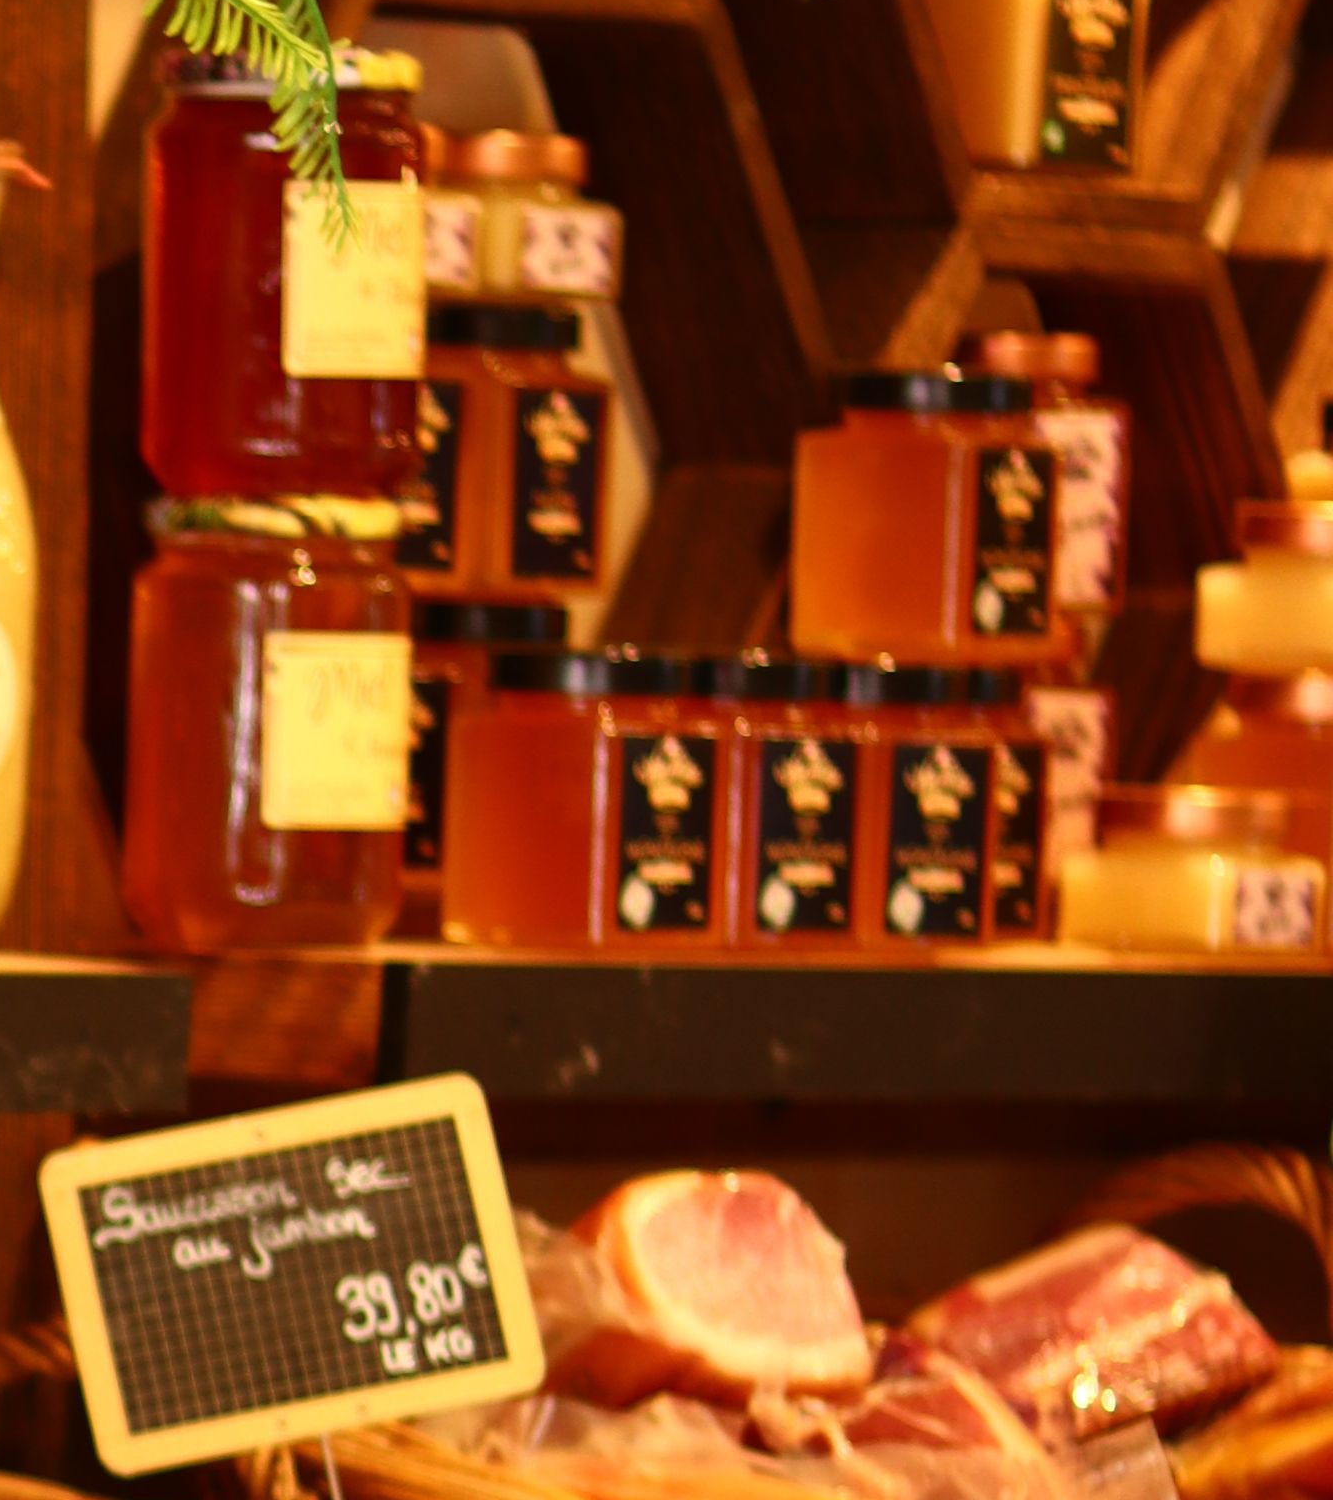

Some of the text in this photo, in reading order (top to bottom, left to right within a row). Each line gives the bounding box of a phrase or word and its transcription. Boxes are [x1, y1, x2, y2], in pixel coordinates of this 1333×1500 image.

[93, 1177, 299, 1251] Saucisson
[172, 1206, 377, 1281] au jambon
[381, 1326, 477, 1374] LE KG
